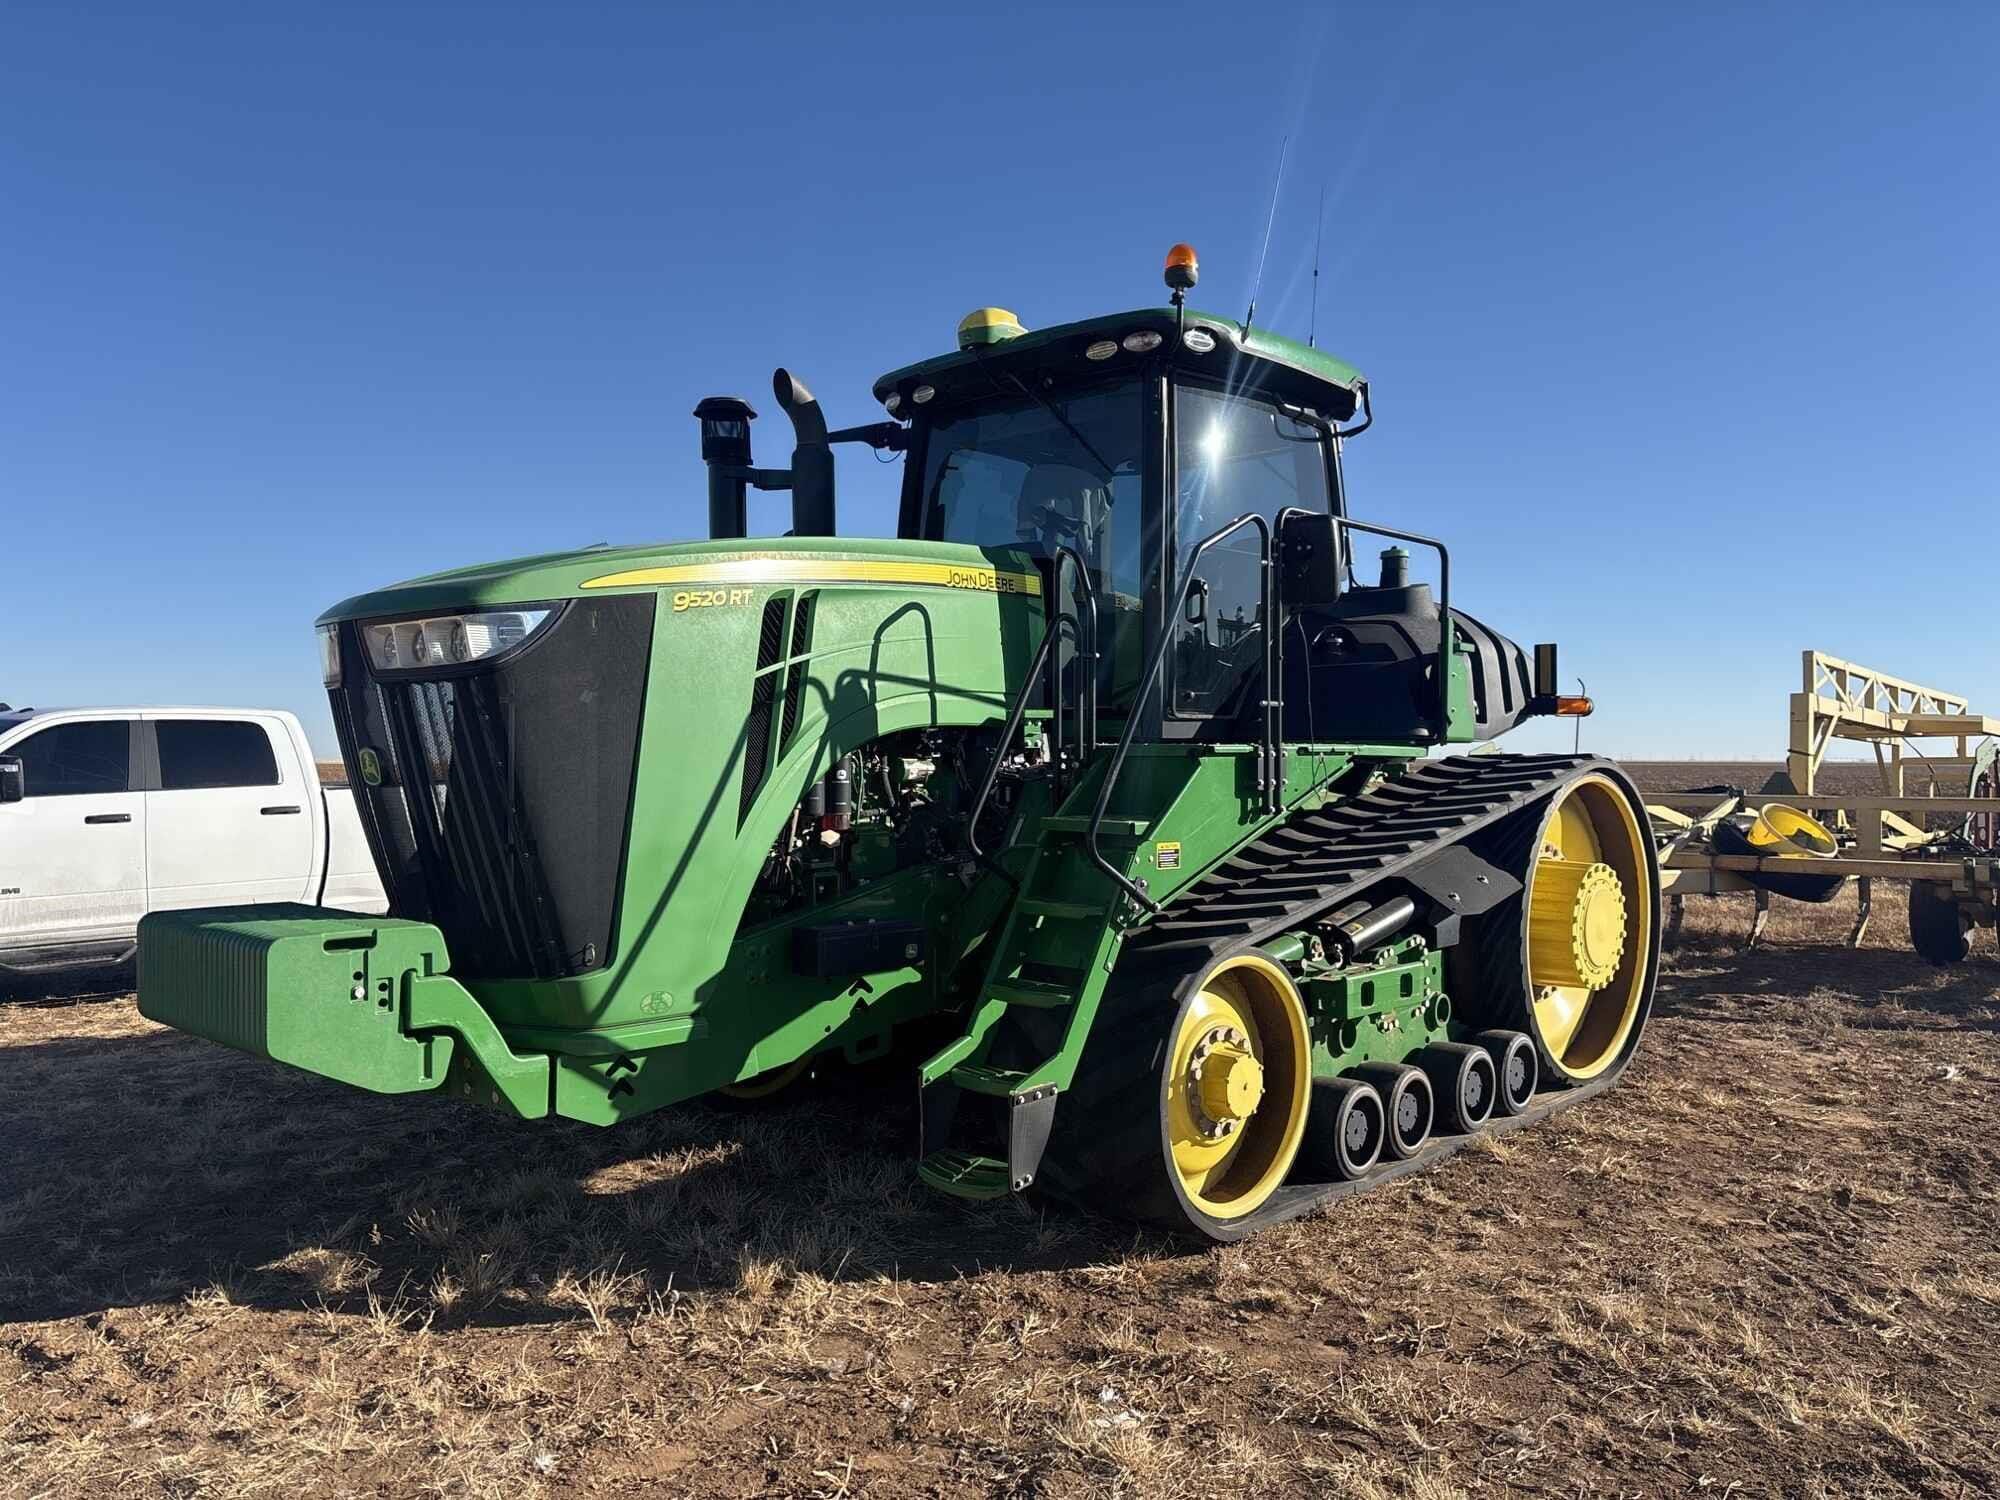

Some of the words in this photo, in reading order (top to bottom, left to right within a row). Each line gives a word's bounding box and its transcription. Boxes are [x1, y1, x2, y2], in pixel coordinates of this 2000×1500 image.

[946, 568, 977, 587] JOHN
[978, 572, 1015, 592] DEERE
[673, 590, 727, 612] 9520
[729, 588, 753, 606] RT
